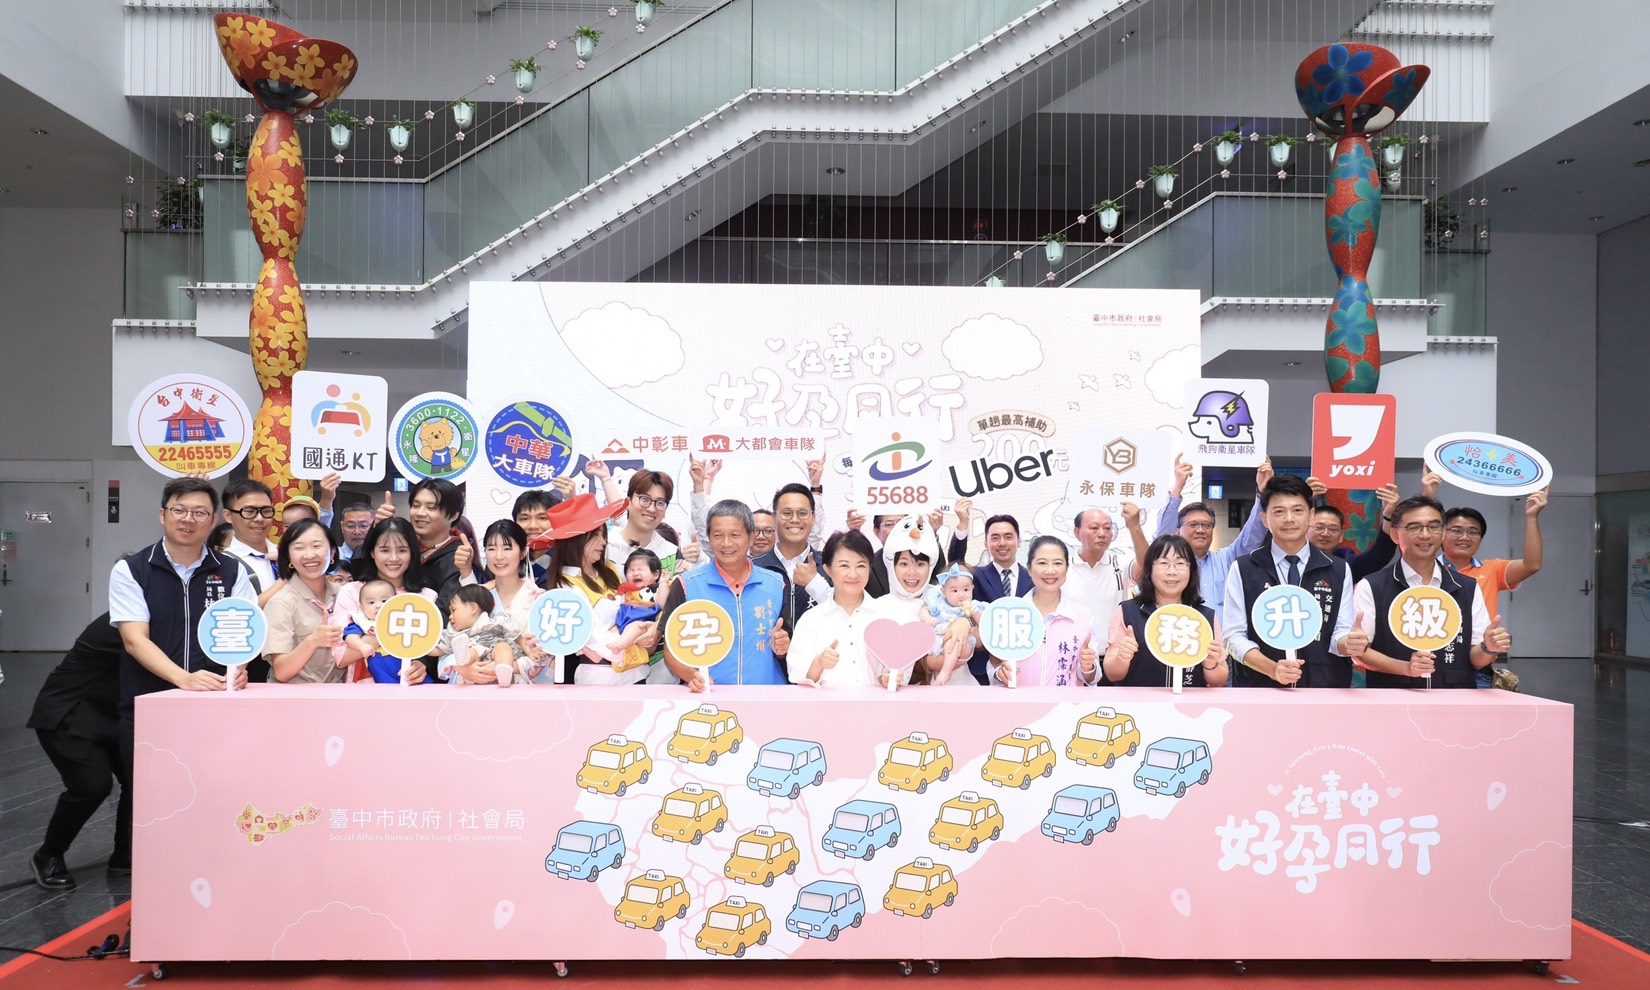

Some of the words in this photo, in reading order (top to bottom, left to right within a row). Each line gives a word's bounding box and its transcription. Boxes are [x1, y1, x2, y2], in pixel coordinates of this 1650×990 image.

[787, 323, 895, 379] 在臺中
[405, 406, 465, 431] 3600-1122
[977, 414, 1048, 432] 單趟最高補助
[159, 445, 232, 461] 22465555
[505, 434, 553, 459] 中華
[632, 435, 689, 452] 中彰車
[736, 437, 816, 451] 大都會車隊
[1198, 445, 1256, 455] 飛狗衛星車隊
[493, 454, 555, 480] 大車隊
[949, 448, 1054, 498] Uber
[1329, 460, 1376, 477] yoxi
[1456, 456, 1522, 477] 24366666
[867, 485, 929, 505] 55688
[1080, 480, 1156, 498] 永保車隊
[387, 603, 429, 648] 中
[539, 599, 584, 646] 好
[991, 607, 1033, 649] 服
[1266, 595, 1310, 638] 升
[1402, 597, 1448, 638] 級
[210, 607, 254, 654] 臺
[679, 611, 722, 655] 孕
[1158, 614, 1201, 656] 務
[1285, 770, 1379, 820] 在臺中
[329, 808, 442, 829] 臺中市政府
[457, 808, 525, 829] 社會局
[329, 833, 355, 841] Social
[356, 833, 383, 841] Affairs
[384, 833, 414, 841] Bureau
[415, 833, 452, 843] Taichung
[453, 833, 470, 843] City
[472, 833, 523, 841] Government
[1215, 810, 1441, 894] 好孕同行
